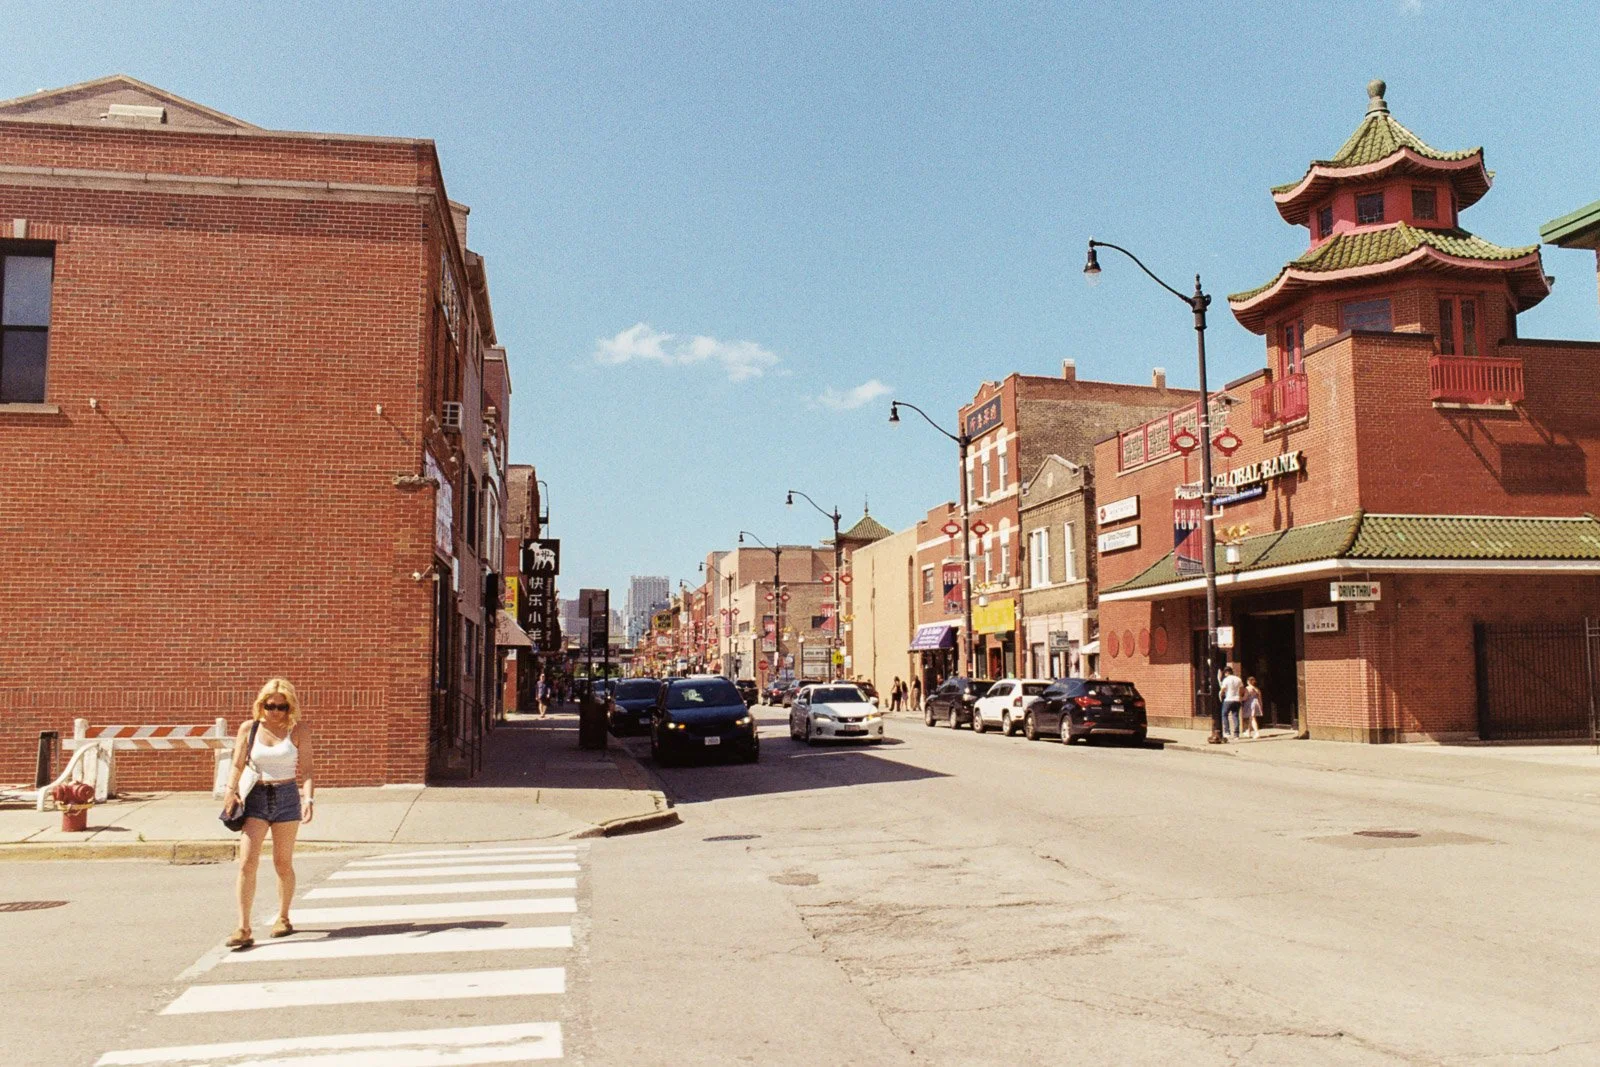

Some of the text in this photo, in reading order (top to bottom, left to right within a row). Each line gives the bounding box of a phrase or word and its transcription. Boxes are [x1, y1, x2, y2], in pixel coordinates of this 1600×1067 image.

[1215, 450, 1300, 488] GLOBAL BANK
[1174, 508, 1201, 520] CHINA
[1174, 519, 1201, 530] TOWN
[1338, 584, 1371, 597] DRIVE THRU
